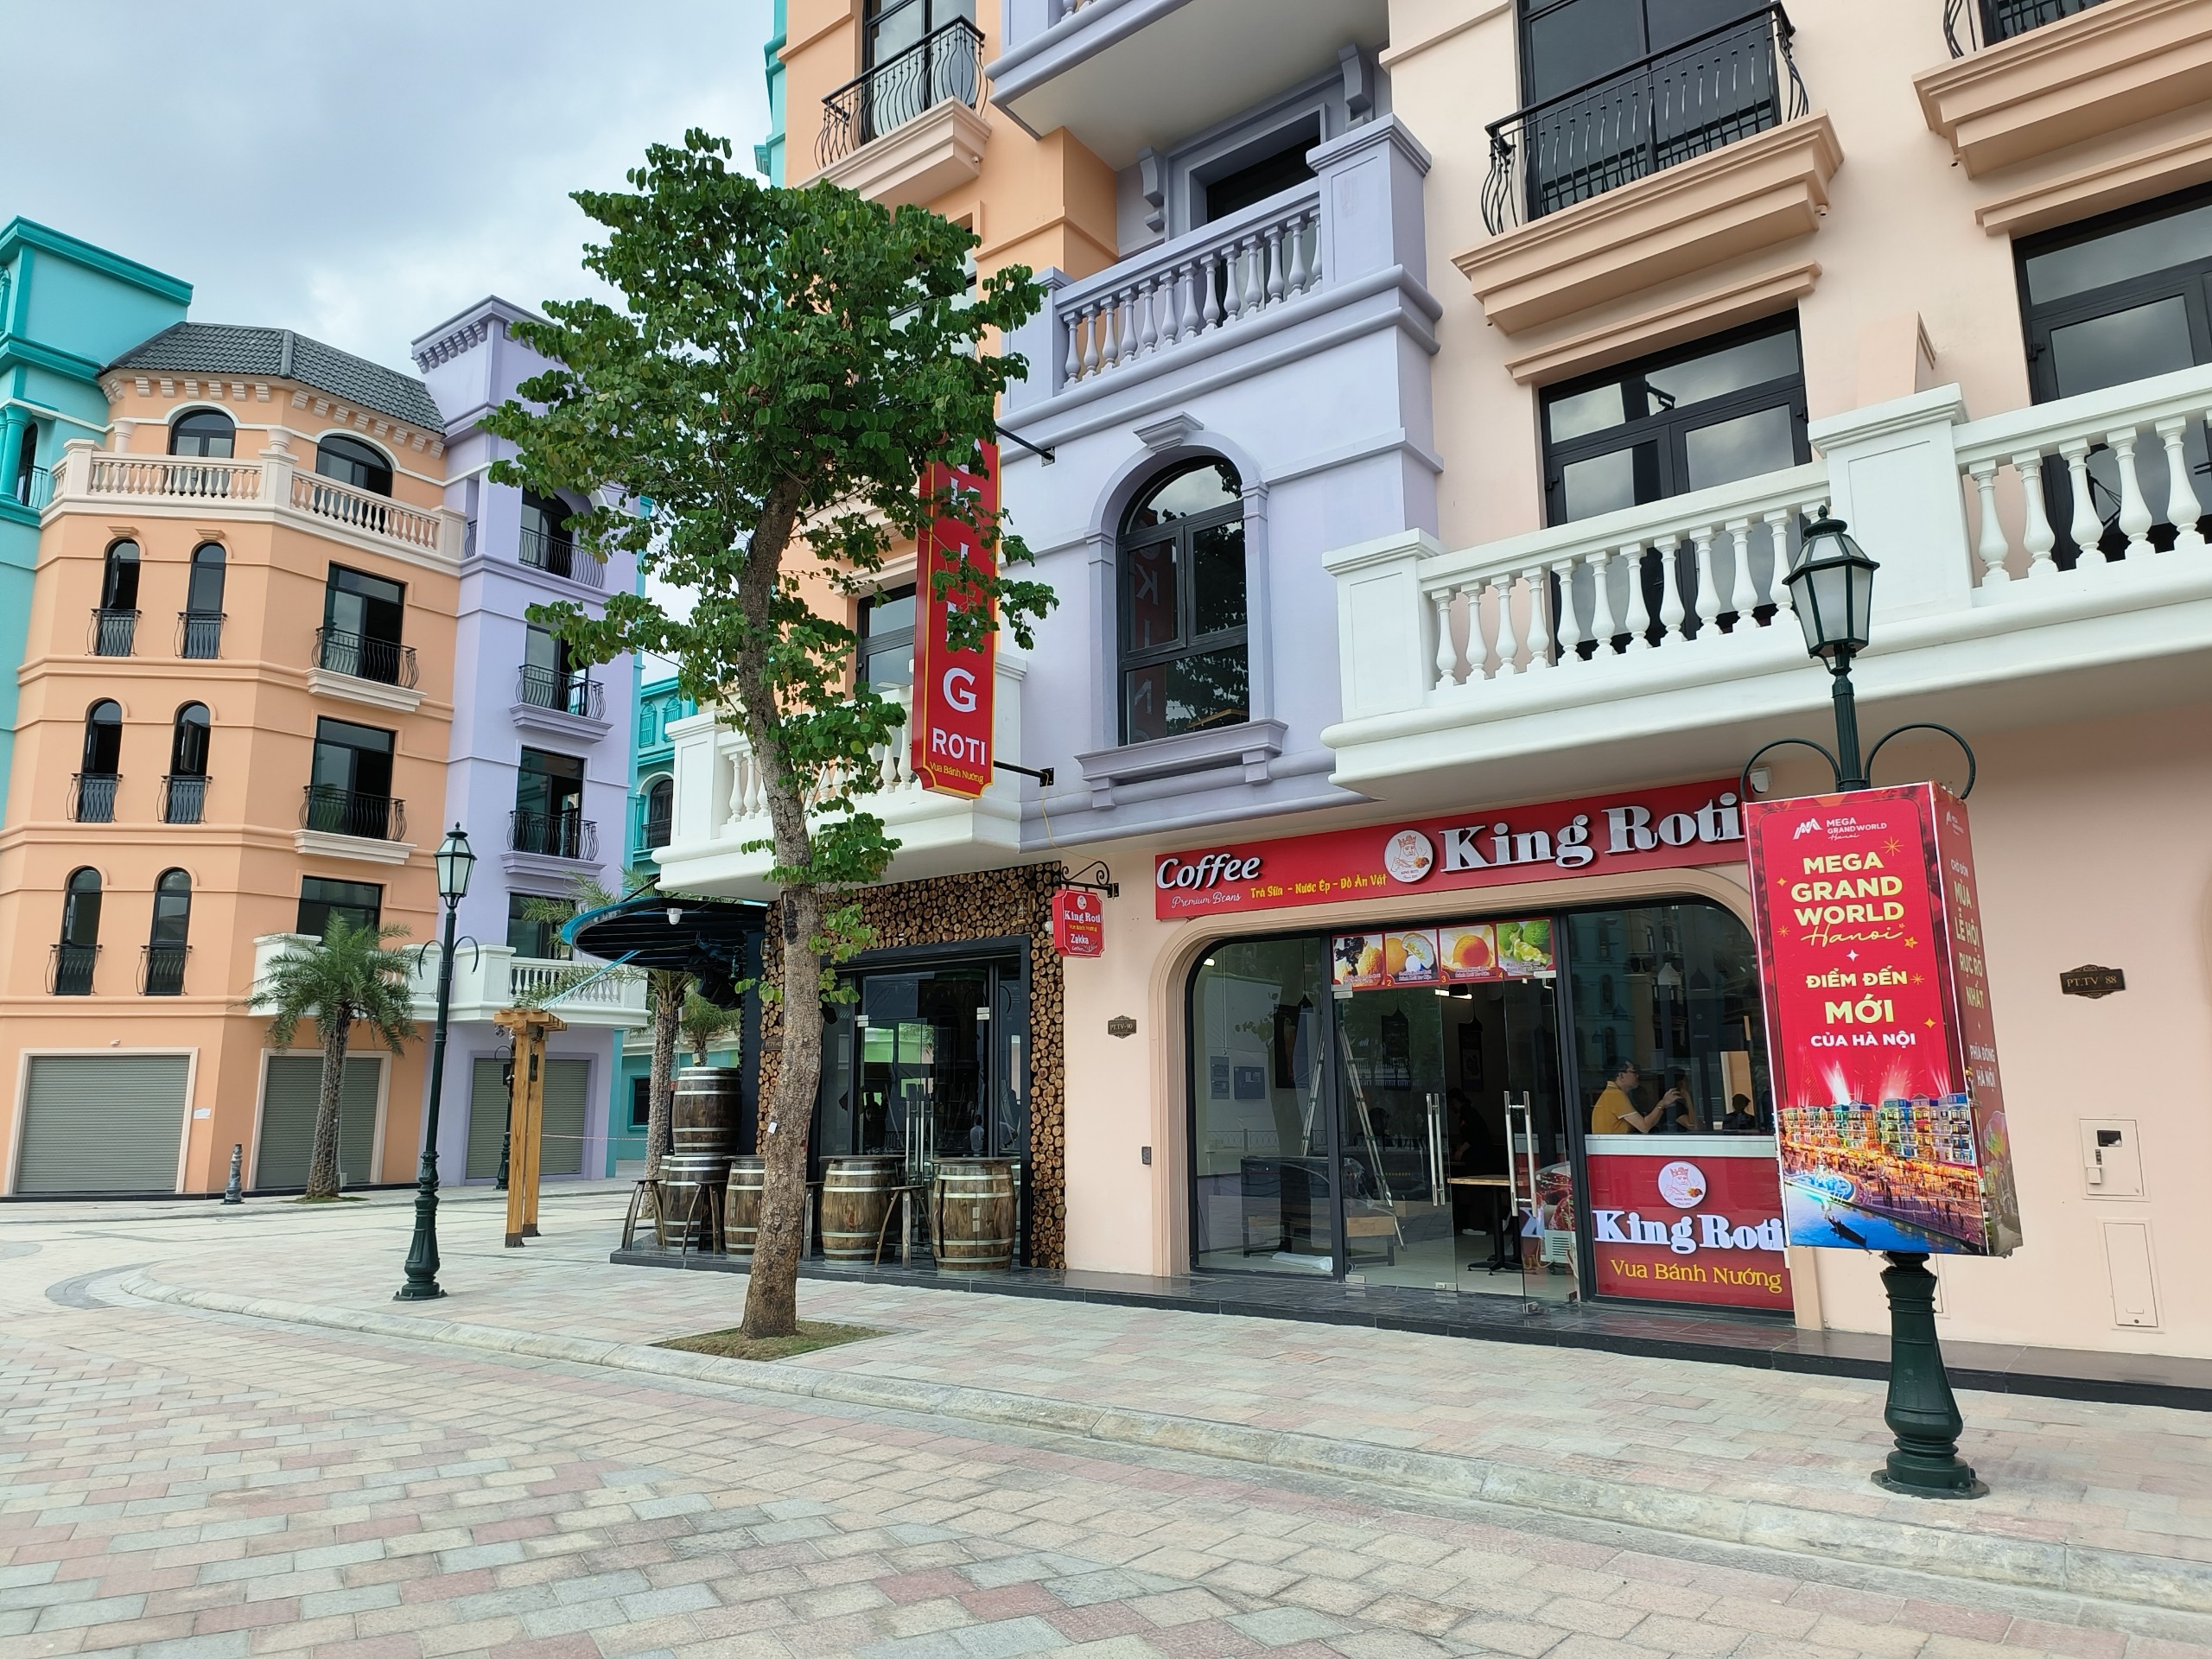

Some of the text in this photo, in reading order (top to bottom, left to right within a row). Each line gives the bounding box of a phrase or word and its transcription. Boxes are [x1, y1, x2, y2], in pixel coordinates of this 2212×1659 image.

[932, 727, 986, 766] ROTI
[930, 761, 943, 772] Vua
[944, 766, 961, 778] Bánh
[1439, 792, 1745, 868] King Roti
[1826, 817, 1857, 828] MEGA
[1827, 823, 1887, 835] GRAND WORLD
[1156, 853, 1262, 891] Coffee
[1802, 851, 1885, 875] MEGA
[1171, 891, 1242, 909] Premium Beans
[1250, 887, 1266, 899] Trà
[1319, 878, 1331, 895] Ép
[1790, 875, 1904, 903] GRAND
[1954, 878, 1973, 909] MÙA
[1064, 910, 1084, 924] King
[1793, 901, 1904, 926] WORLD
[1070, 933, 1089, 944] Zakka
[1800, 923, 1904, 948] Hanoi
[1806, 964, 1908, 988] ĐIỂM ĐẾN
[2066, 975, 2117, 987] PT.TV 88
[1824, 993, 1894, 1024] MỚI
[1810, 1030, 1916, 1049] CỦA HÀ NỘI
[1592, 1210, 1698, 1255] King
[1696, 1213, 1786, 1252] Roti
[1611, 1258, 1783, 1294] Vua Bánh Nướng
